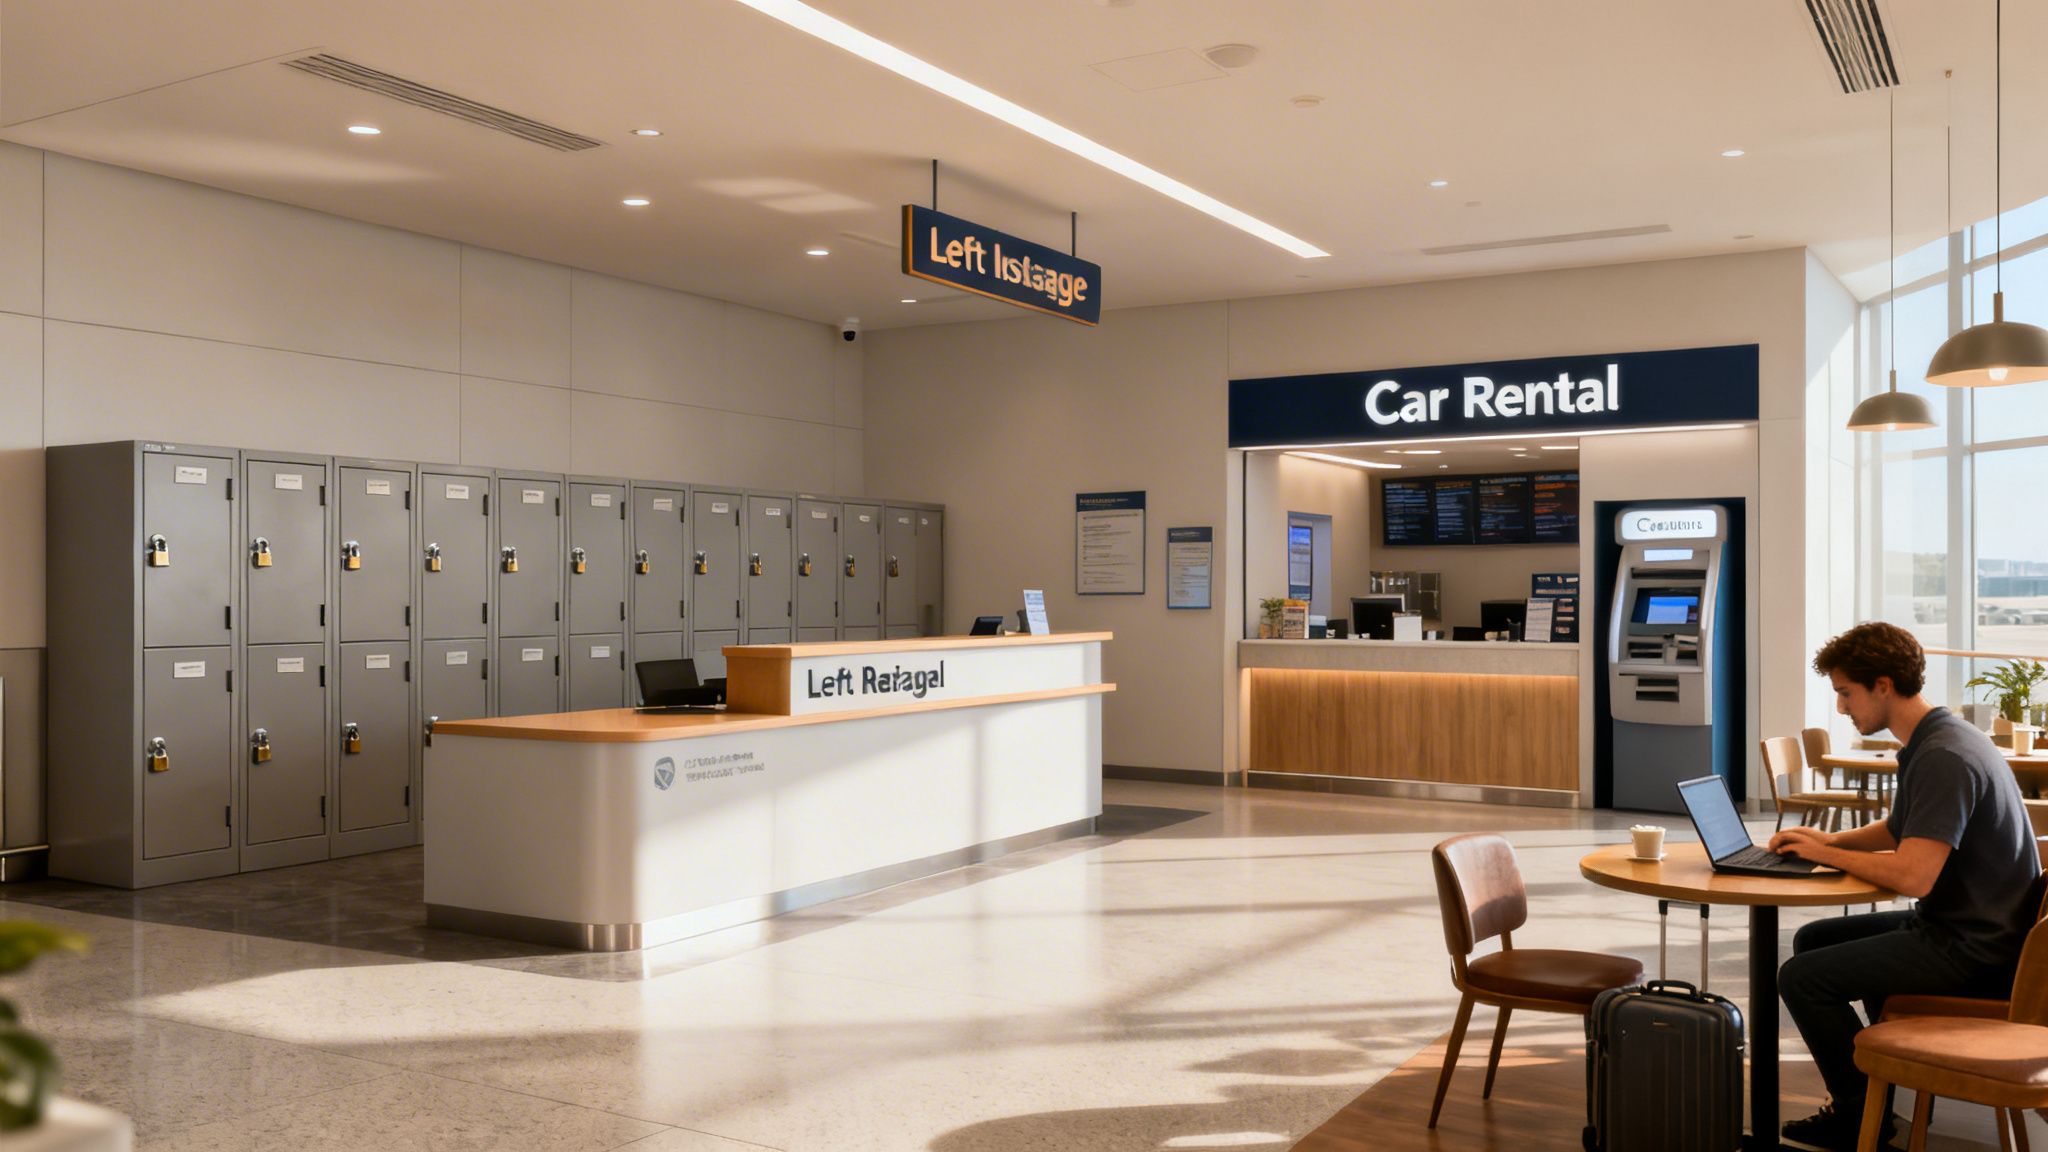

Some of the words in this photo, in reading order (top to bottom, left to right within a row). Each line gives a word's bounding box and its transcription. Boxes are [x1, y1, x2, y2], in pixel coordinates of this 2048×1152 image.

[930, 226, 987, 275] Left
[1364, 380, 1449, 425] Car
[1463, 364, 1619, 419] Rental
[808, 667, 854, 699] Left
